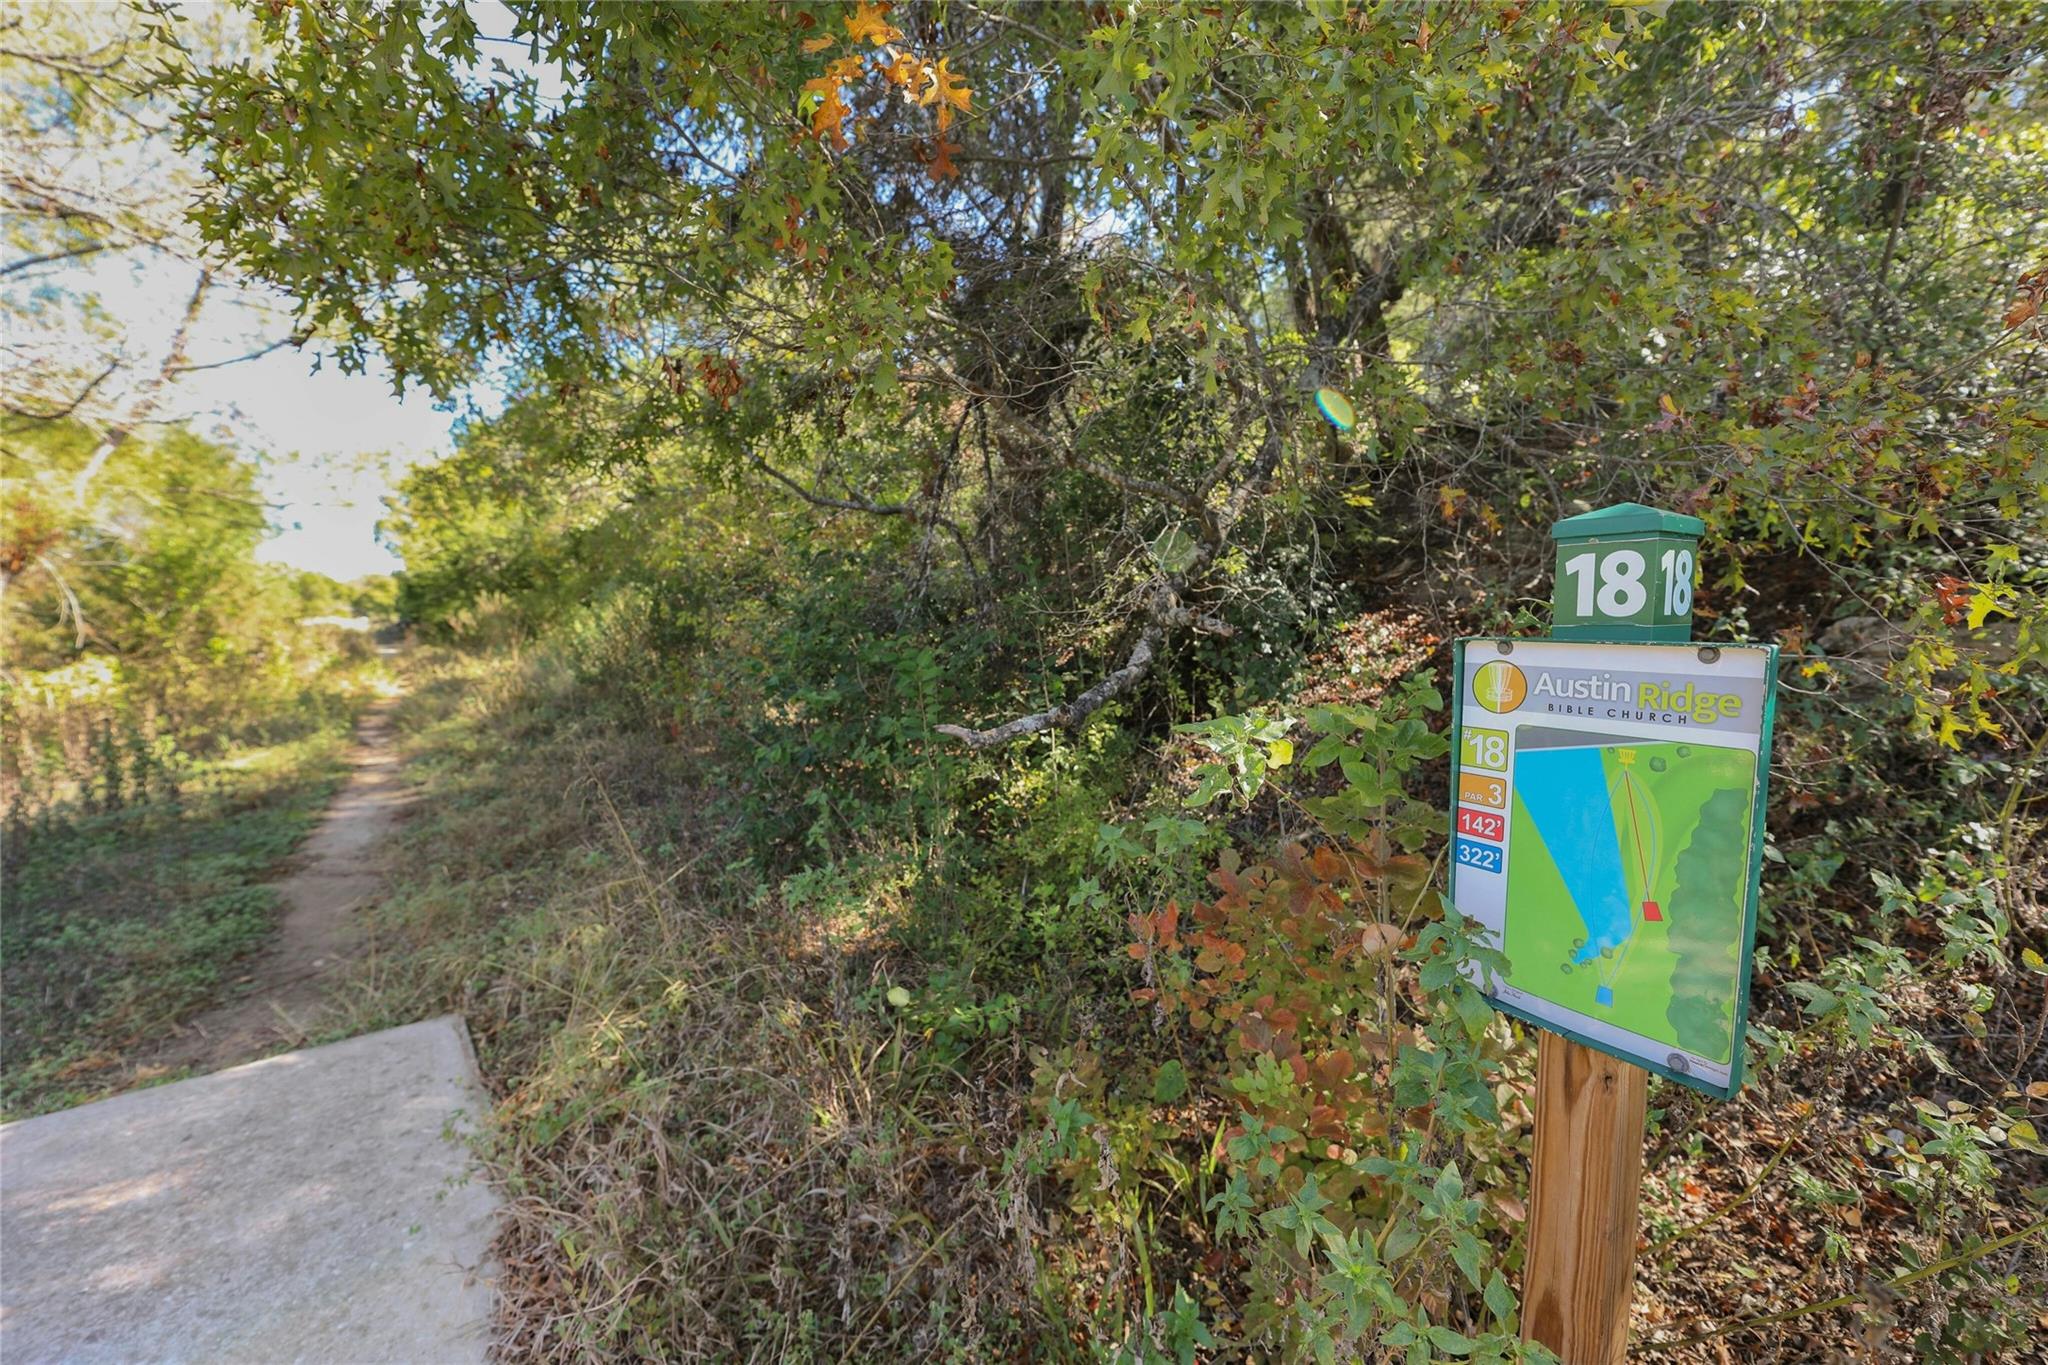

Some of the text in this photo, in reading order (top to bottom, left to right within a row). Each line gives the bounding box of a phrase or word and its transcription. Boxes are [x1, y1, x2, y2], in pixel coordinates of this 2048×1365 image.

[1565, 550, 1647, 617] 18
[1661, 549, 1693, 617] 18
[1533, 672, 1742, 724] Austin Ridge
[1548, 703, 1688, 725] BIBLE CHURCH
[1463, 729, 1506, 768] #18
[1464, 783, 1502, 805] PAR 3
[1462, 813, 1501, 837] 142'
[1459, 844, 1500, 869] 322'
